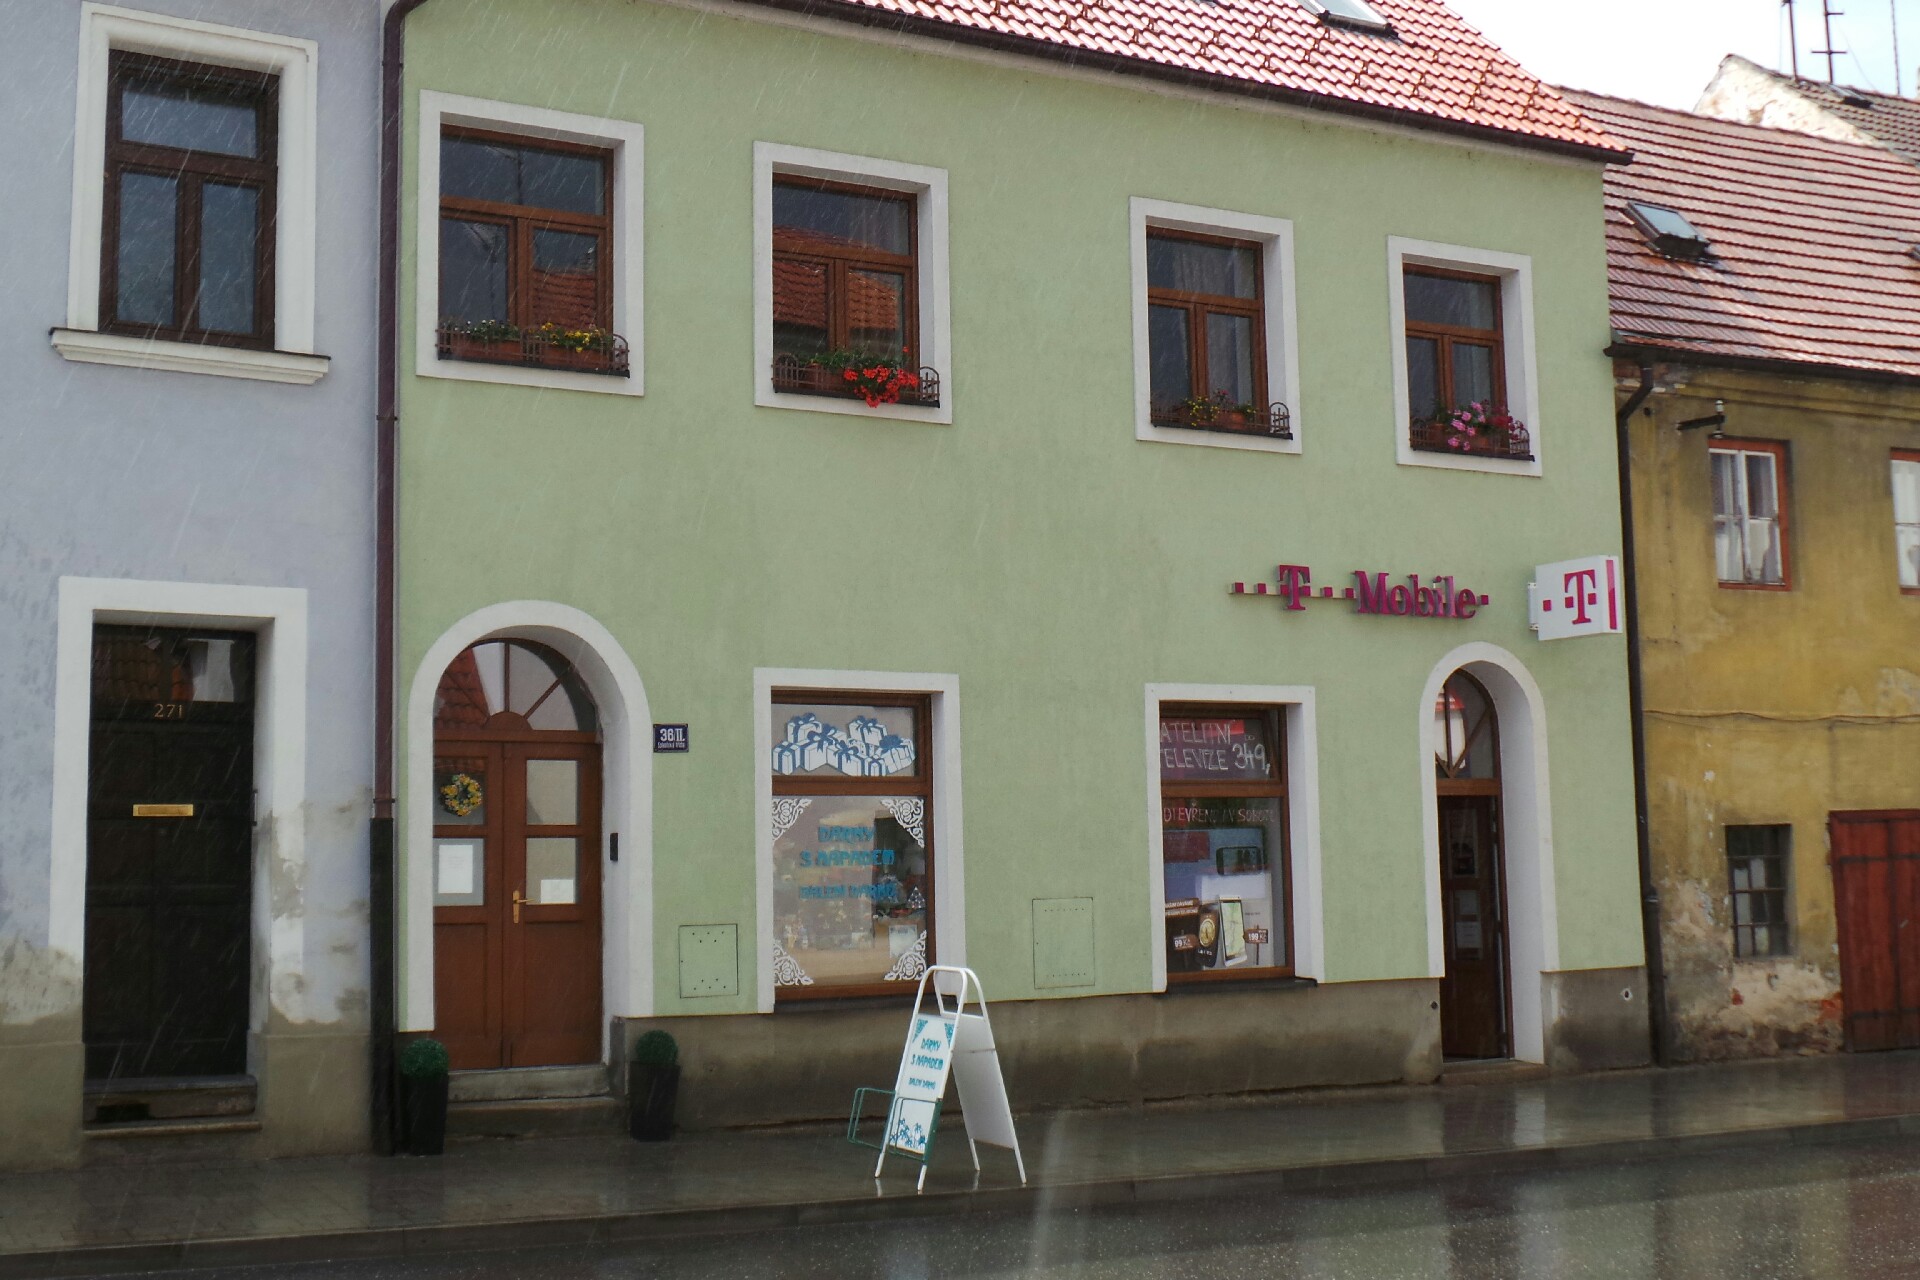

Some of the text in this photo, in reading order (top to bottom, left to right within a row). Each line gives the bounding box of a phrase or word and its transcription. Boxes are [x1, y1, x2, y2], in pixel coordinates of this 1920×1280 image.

[1353, 570, 1477, 619] Mobile
[1563, 569, 1597, 626] T
[154, 703, 185, 719] 271
[799, 849, 813, 868] S
[911, 1053, 916, 1065] S
